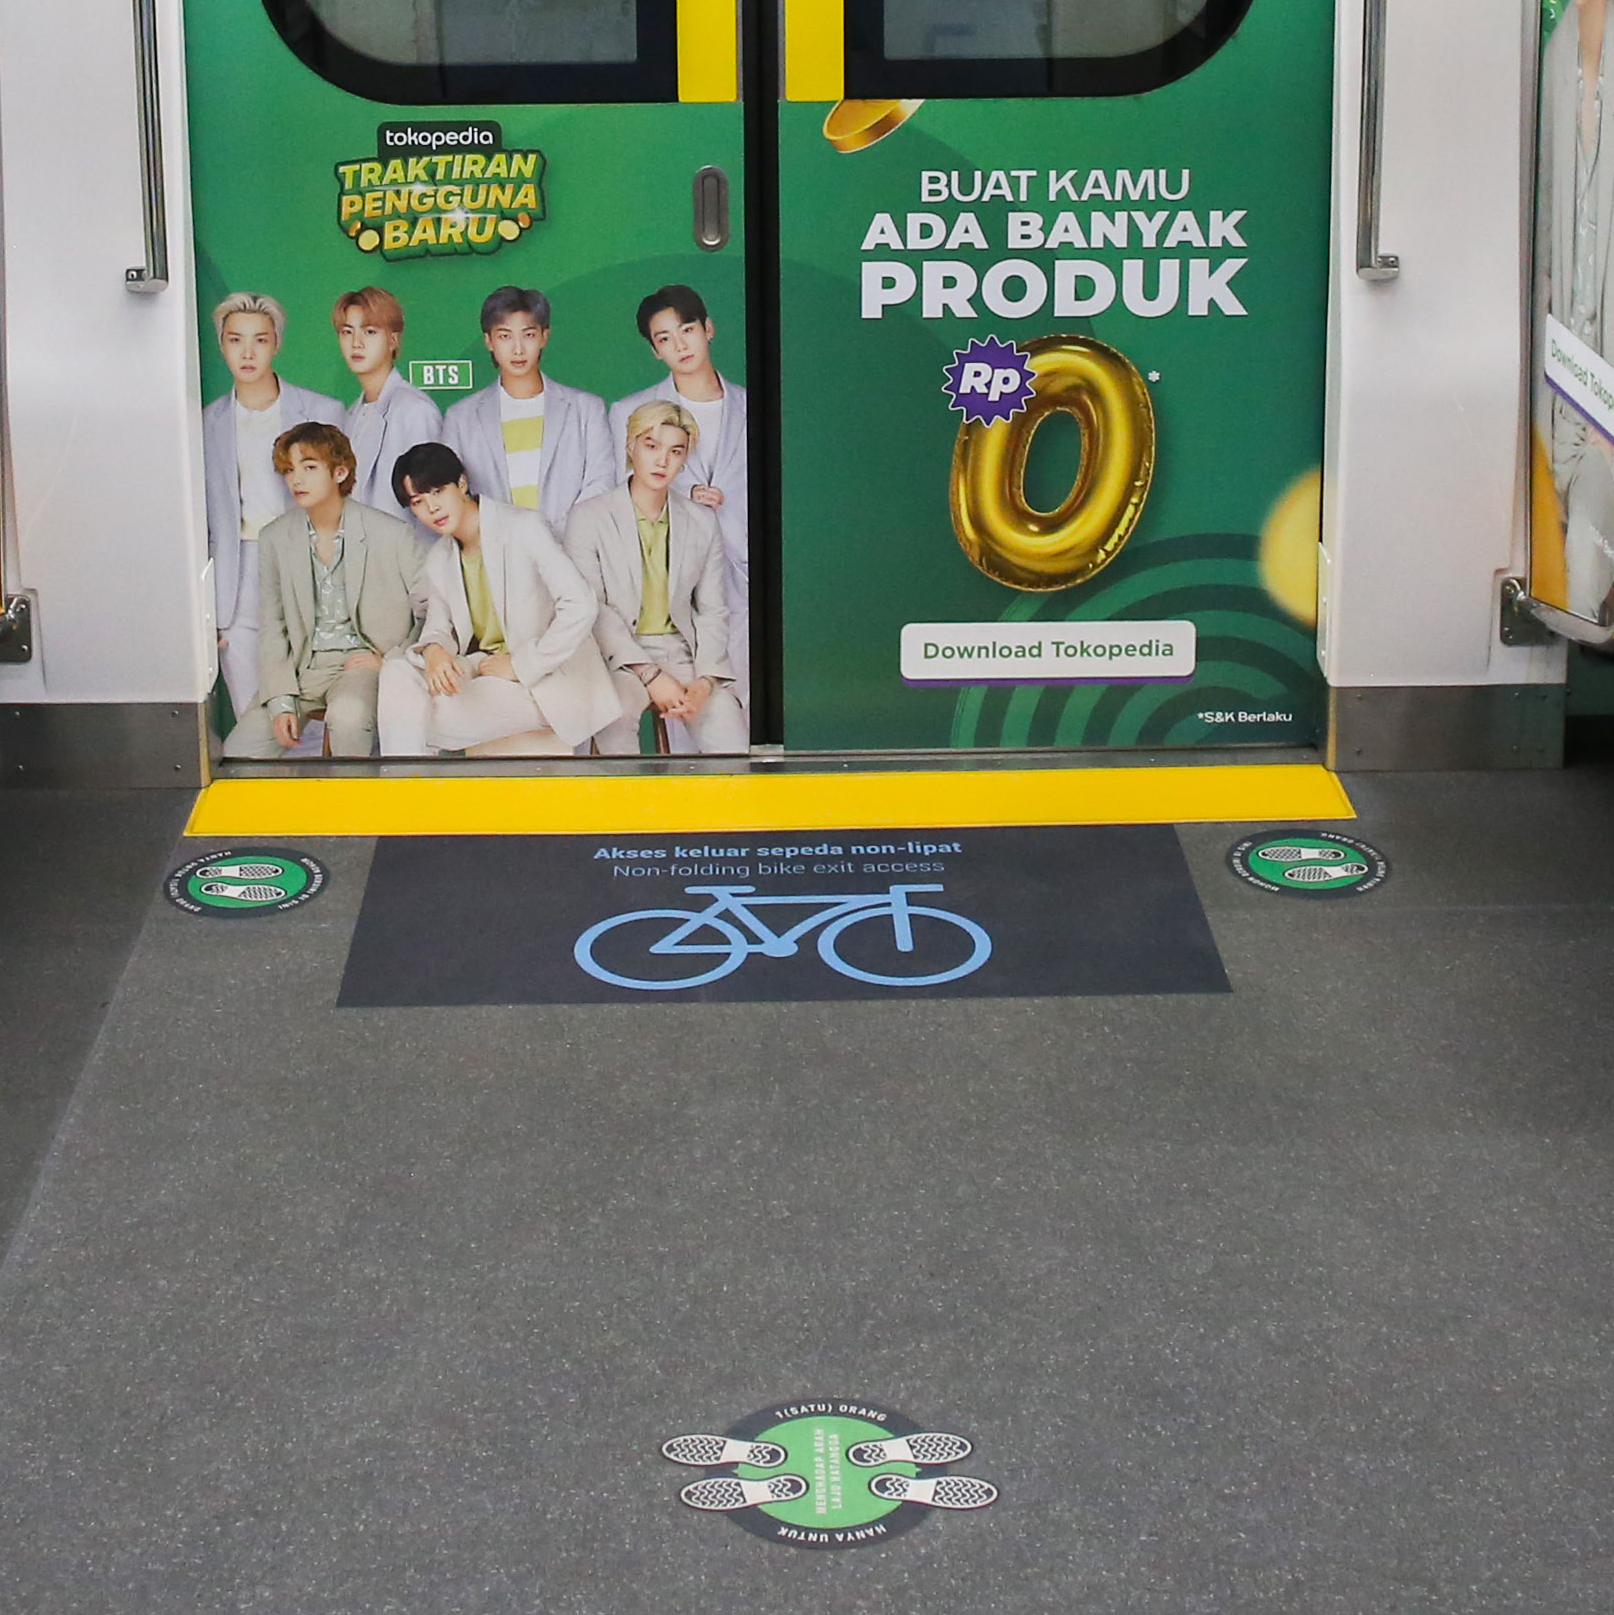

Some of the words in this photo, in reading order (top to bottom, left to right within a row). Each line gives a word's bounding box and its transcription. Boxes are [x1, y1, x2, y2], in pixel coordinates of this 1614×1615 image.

[385, 125, 494, 150] tokopedia
[338, 153, 539, 190] TRAKTIRAN
[920, 170, 1037, 203] BUAT
[1046, 168, 1191, 202] KAMU
[340, 183, 538, 223] PENGGUNA
[383, 215, 499, 250] BARU
[860, 212, 989, 251] ADA
[1005, 210, 1249, 250] BANYAK
[860, 257, 1250, 320] PRODUK
[421, 363, 460, 386] BTS
[1551, 338, 1588, 387] Download
[958, 361, 1022, 402] Rp
[922, 639, 1042, 660] Download
[1050, 636, 1175, 665] Tokopedia
[1237, 709, 1293, 723] Berlaku
[593, 846, 667, 860] Akses
[674, 844, 749, 858] keluar
[756, 843, 844, 859] sepeda
[850, 841, 963, 857] non-lipat
[612, 862, 750, 879] Non-folding
[757, 861, 806, 875] bike
[813, 860, 854, 874] exit
[862, 860, 946, 873] access
[838, 1404, 888, 1423] ORANG
[776, 1524, 830, 1543] UNTUK
[835, 1523, 888, 1543] HANYA
